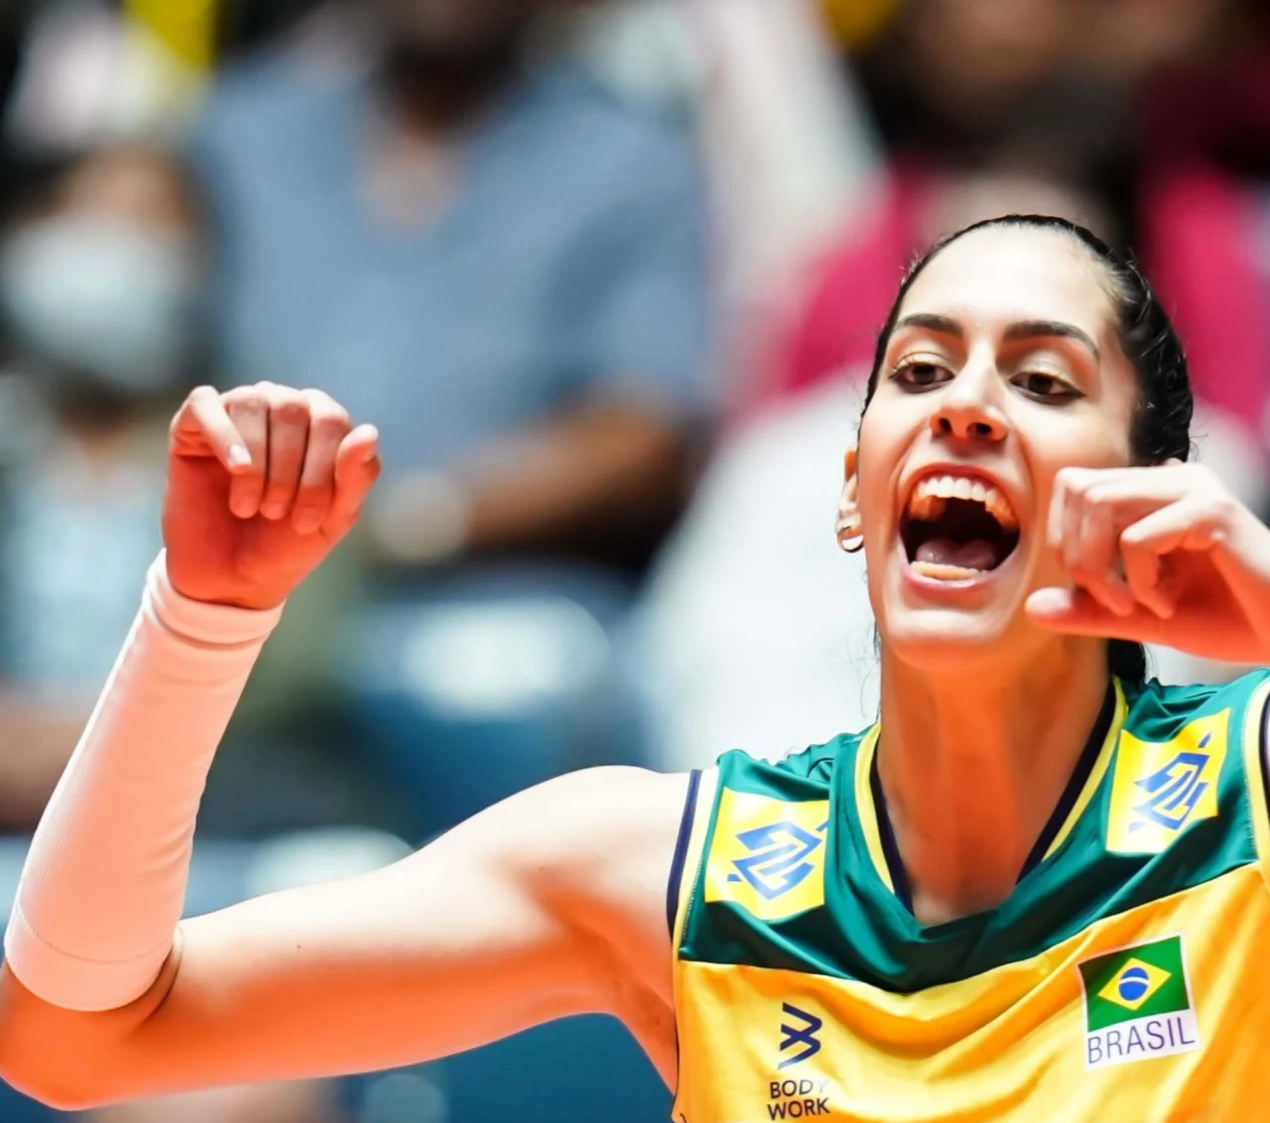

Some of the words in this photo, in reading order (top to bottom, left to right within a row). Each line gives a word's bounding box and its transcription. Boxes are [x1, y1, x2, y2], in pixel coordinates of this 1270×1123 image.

[1087, 1016, 1196, 1064] BRASIL
[769, 1079, 829, 1099] BODY
[766, 1097, 831, 1121] WORK
